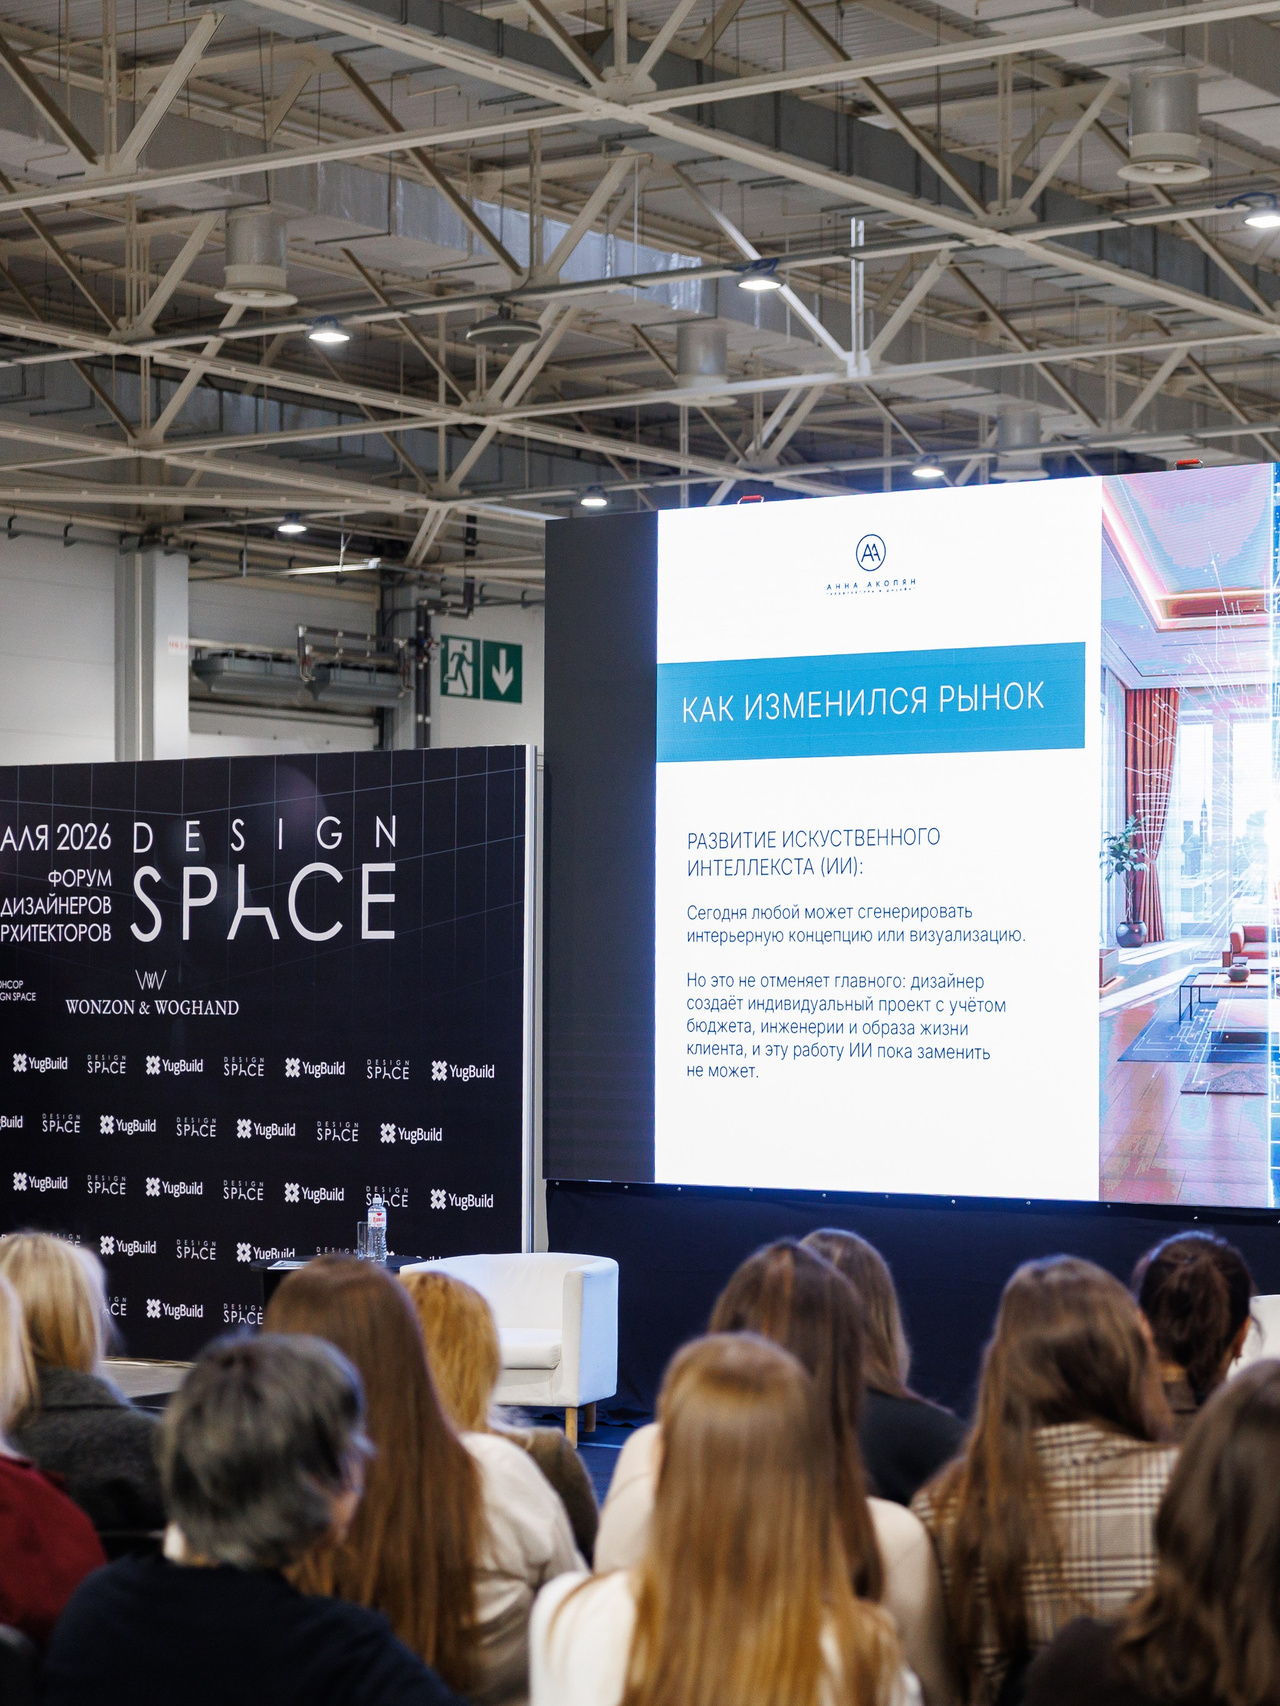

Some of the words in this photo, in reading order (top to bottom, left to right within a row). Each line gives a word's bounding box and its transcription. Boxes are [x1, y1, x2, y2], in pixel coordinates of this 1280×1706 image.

[826, 582, 859, 591] АННА
[867, 578, 917, 587] АКОПЯН
[684, 695, 733, 723] КАК
[746, 687, 926, 720] ИЗМЕНИЛСЯ
[940, 681, 1044, 712] РЫНОК
[57, 823, 111, 850] 2026
[134, 815, 395, 853] DESIGN
[688, 831, 776, 849] РАЗВИТИЕ
[783, 828, 940, 848] ИСКУСТВЕННОГО
[688, 858, 814, 876] ИНТЕЛЛЕКСТА
[821, 856, 862, 877] (ИИ):
[48, 869, 111, 887] ФОРУМ
[0, 893, 111, 917] ДИЗАЙНЕРОВ
[130, 862, 395, 942] SPACE
[687, 905, 747, 922] Сегодня
[752, 904, 799, 919] любой
[805, 907, 853, 919] может
[858, 906, 972, 922] сгенерировать
[1, 924, 111, 942] РХИТЕКТОРОВ
[688, 931, 784, 946] интерьерную
[789, 930, 872, 945] концепцию
[878, 930, 904, 941] или
[910, 930, 1025, 946] визуализацию.
[688, 973, 706, 987] Но
[711, 976, 734, 987] это
[739, 976, 755, 987] не
[761, 976, 830, 988] отменяет
[835, 976, 905, 988] главного:
[911, 973, 984, 992] дизайнер
[13, 992, 37, 1001] SPACE
[66, 1000, 135, 1014] WONZON
[139, 1001, 149, 1014] &
[155, 1000, 239, 1015] WOGHAND
[687, 995, 743, 1012] создаёт
[748, 996, 873, 1014] индивидуальный
[879, 1000, 931, 1015] проект
[936, 1000, 944, 1012] с
[949, 997, 1006, 1016] учётом
[687, 1018, 755, 1035] бюджета,
[761, 1022, 843, 1036] инженерии
[850, 1023, 857, 1034] и
[863, 1020, 914, 1037] образа
[920, 1024, 968, 1035] жизни
[687, 1044, 746, 1058] клиента,
[753, 1045, 760, 1055] и
[766, 1045, 788, 1060] эту
[794, 1042, 844, 1061] работу
[850, 1043, 872, 1057] ИИ
[878, 1046, 912, 1058] пока
[918, 1047, 990, 1060] заменить
[29, 1057, 67, 1073] YugBuild
[88, 1061, 125, 1074] SPACE
[162, 1059, 203, 1075] YugBuild
[224, 1064, 264, 1076] SPACE
[302, 1061, 345, 1078] YugBuild
[367, 1066, 409, 1079] SPACE
[450, 1065, 494, 1081] YugBuild
[687, 1066, 703, 1077] не
[709, 1066, 758, 1078] может.
[0, 1115, 23, 1128] Build
[43, 1121, 80, 1133] SPACE
[116, 1119, 156, 1135] YugBuild
[177, 1117, 216, 1125] DESIGN
[177, 1124, 216, 1137] SPACE
[254, 1123, 295, 1139] YugBuild
[317, 1128, 358, 1141] SPACE
[398, 1128, 442, 1144] YugBuild
[29, 1176, 67, 1192] YugBuild
[88, 1182, 125, 1194] SPACE
[162, 1181, 202, 1197] YugBuild
[224, 1187, 263, 1200] SPACE
[302, 1187, 344, 1204] YugBuild
[449, 1193, 493, 1210] YugBuild
[116, 1240, 156, 1256] YugBuild
[177, 1240, 215, 1248] DESIGN
[177, 1247, 215, 1260] SPACE
[163, 1303, 203, 1320] YugBuild
